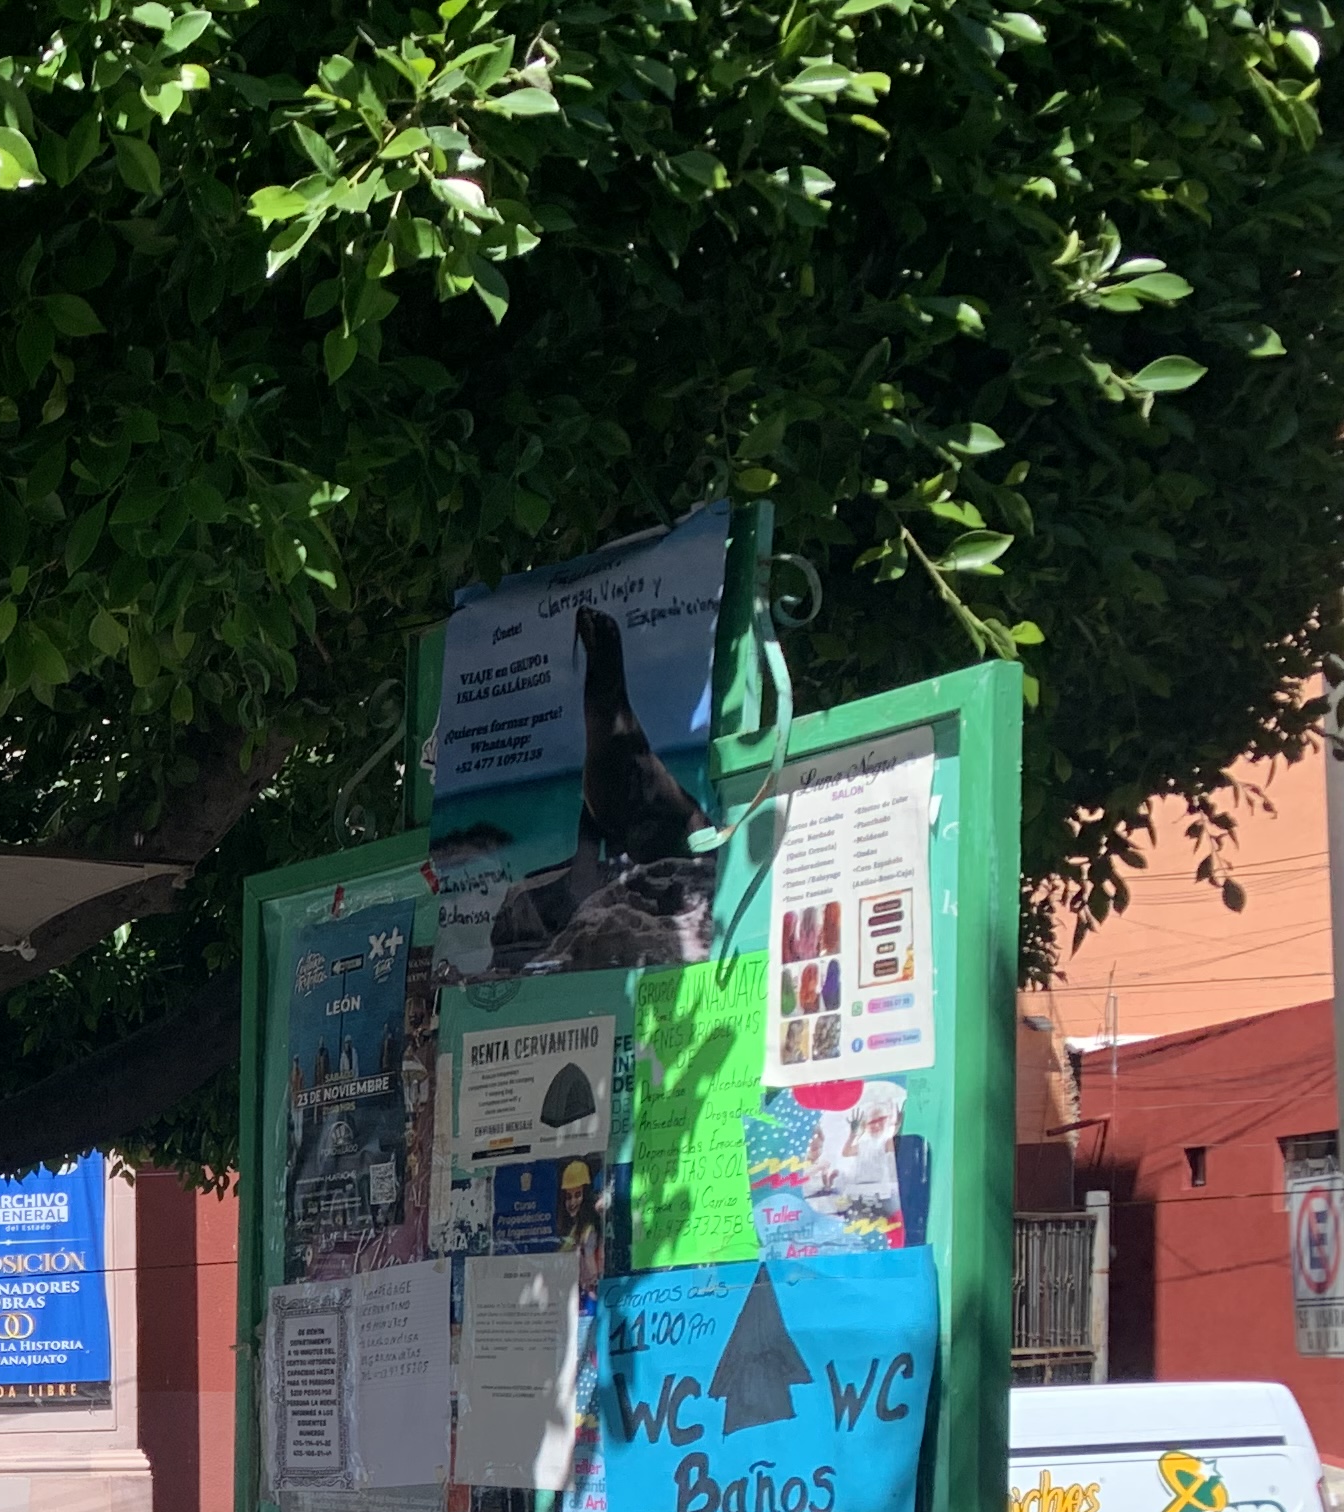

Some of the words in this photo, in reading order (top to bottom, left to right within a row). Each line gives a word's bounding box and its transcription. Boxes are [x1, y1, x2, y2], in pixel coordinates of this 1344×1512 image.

[325, 993, 361, 1017] LEÓN
[471, 1039, 510, 1067] RENTA
[514, 1025, 599, 1059] CERVANTINO
[310, 1090, 321, 1105] DE
[323, 1074, 390, 1102] NOVIEMBRE
[5, 1224, 19, 1232] del
[21, 1223, 51, 1232] Estado
[609, 1309, 687, 1356] 11:00
[0, 1342, 16, 1353] LA
[20, 1340, 83, 1351] HISTORIA
[29, 1383, 77, 1397] LIBRE
[614, 1372, 705, 1447] WC
[826, 1352, 914, 1433] WC
